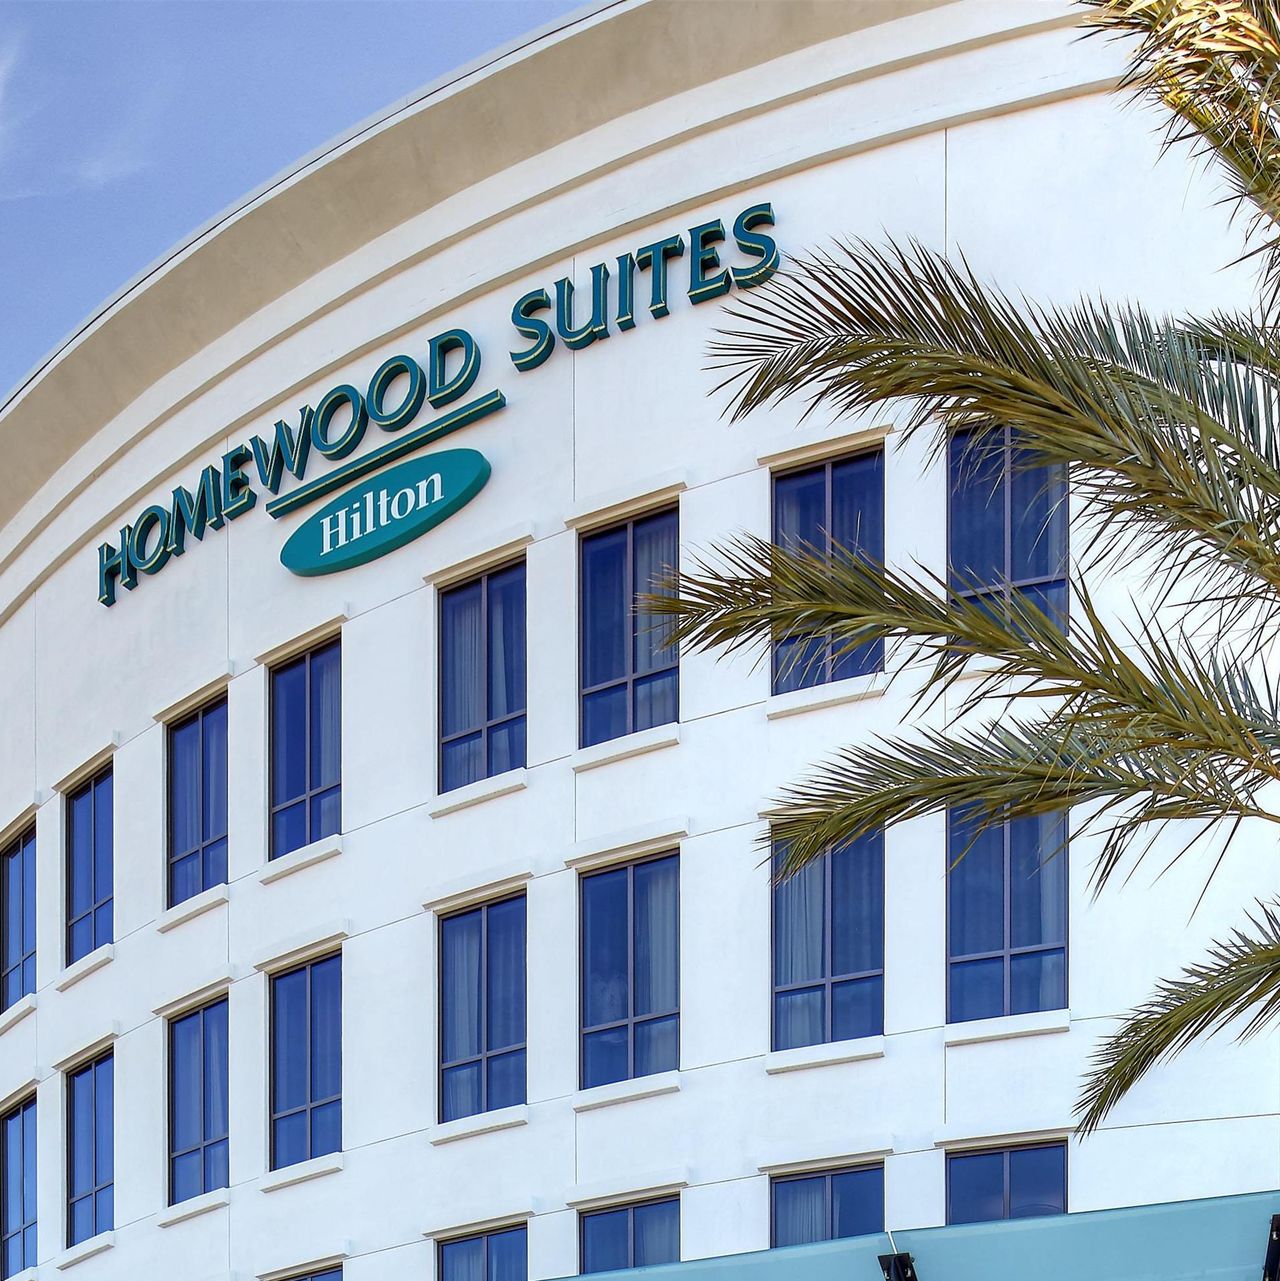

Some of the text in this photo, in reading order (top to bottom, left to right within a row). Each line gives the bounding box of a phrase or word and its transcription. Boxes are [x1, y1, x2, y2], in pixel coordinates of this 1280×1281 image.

[97, 203, 781, 607] HOMEWOOD SUITES
[319, 472, 444, 556] Hilton
